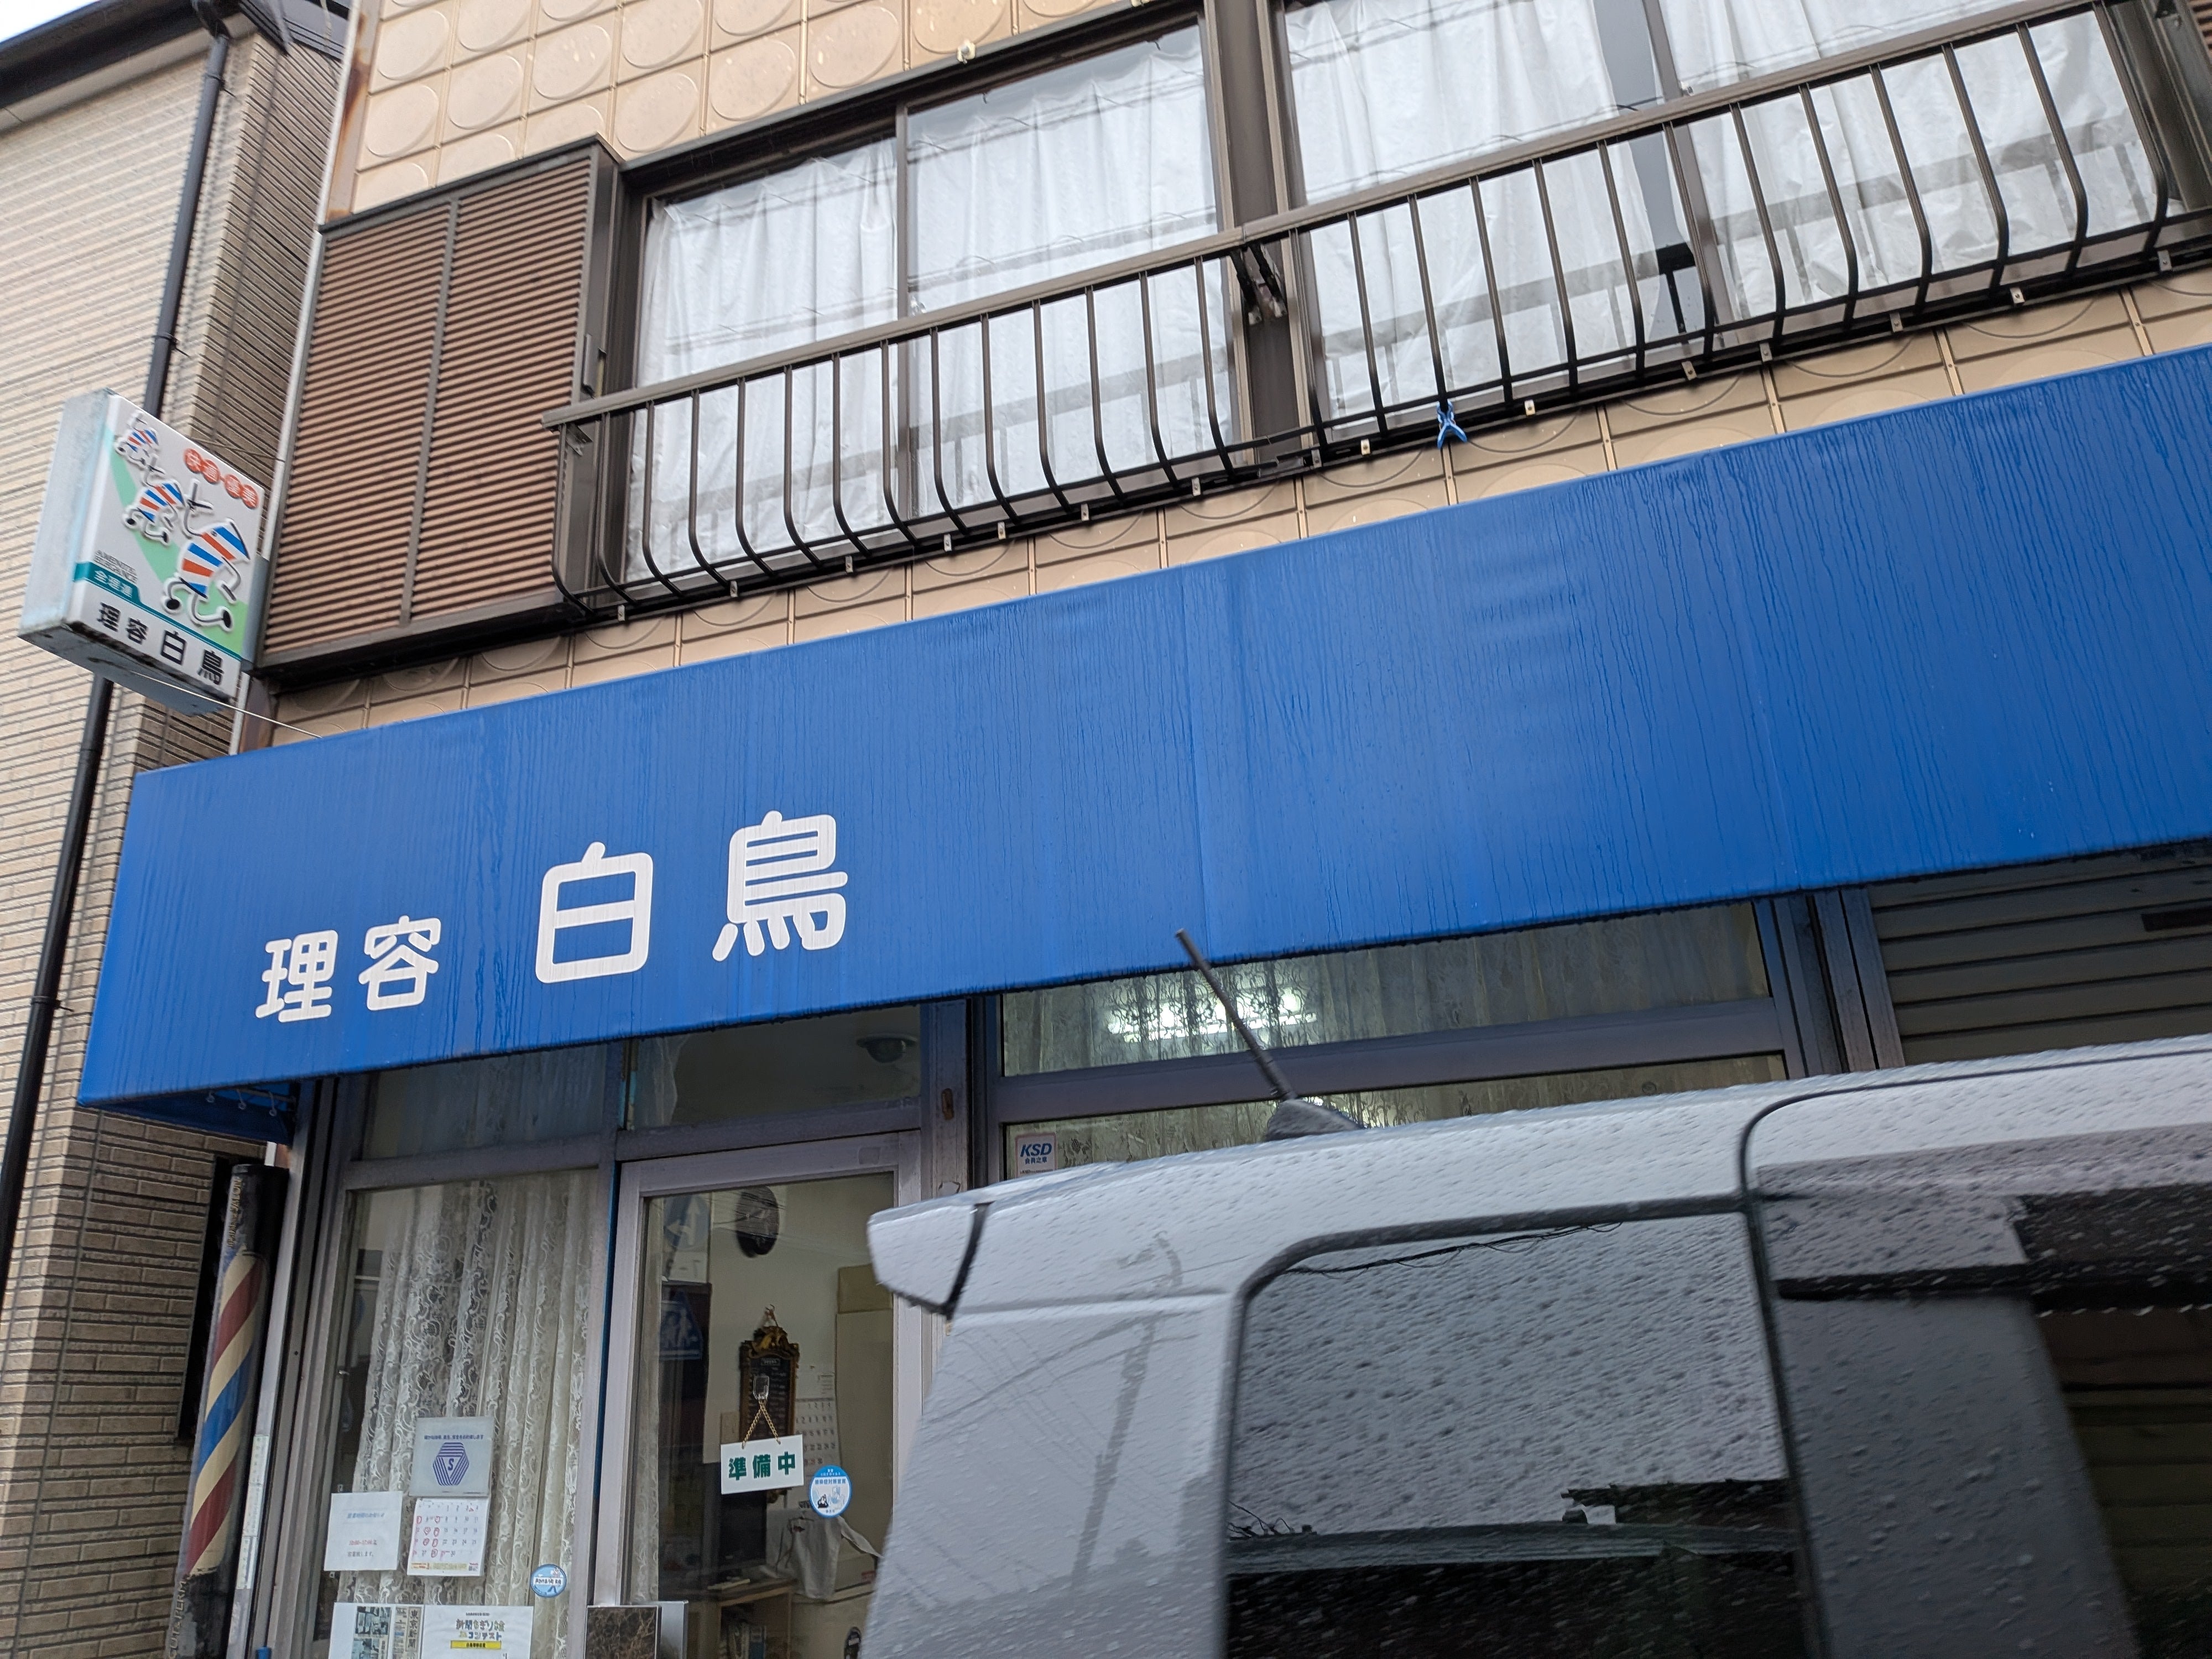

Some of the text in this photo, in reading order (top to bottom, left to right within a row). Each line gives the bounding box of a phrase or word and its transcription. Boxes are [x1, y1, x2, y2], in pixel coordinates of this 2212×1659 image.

[255, 810, 848, 1023] 理容 白鳥
[1020, 1142, 1052, 1157] KSD
[728, 1451, 795, 1480] 準備中
[468, 1631, 502, 1642] コンテスト
